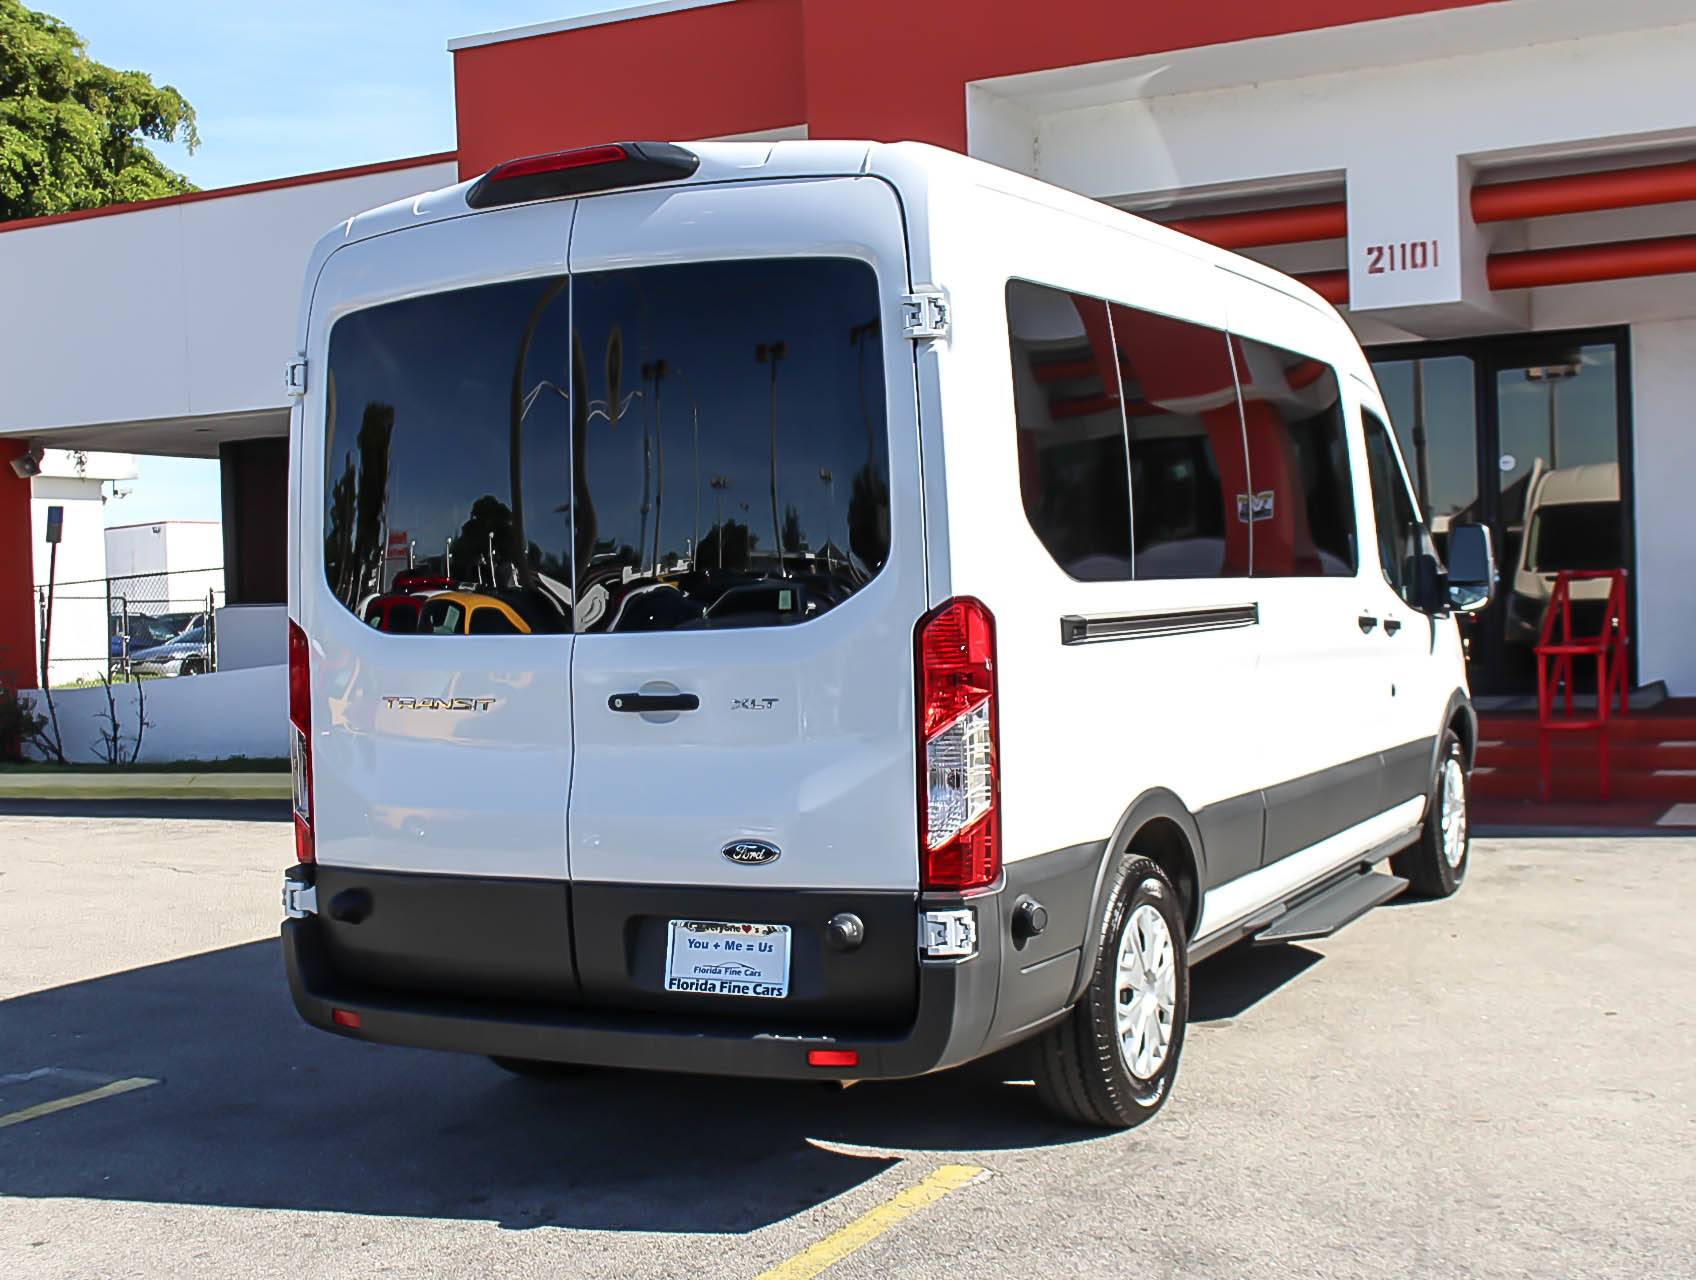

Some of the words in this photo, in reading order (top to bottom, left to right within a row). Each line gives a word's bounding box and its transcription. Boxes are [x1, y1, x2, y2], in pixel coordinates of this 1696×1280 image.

[1367, 240, 1438, 274] 21101
[382, 696, 496, 711] TRANSIT
[731, 698, 779, 710] XLT
[732, 844, 766, 860] Ford
[688, 938, 709, 949] You
[724, 940, 743, 951] Me
[758, 941, 774, 953] Us
[693, 966, 722, 975] Florida
[724, 967, 742, 976] Fine
[744, 968, 762, 977] Cars
[668, 977, 716, 993] Florida
[719, 981, 750, 995] Fine
[752, 983, 783, 997] Cars
